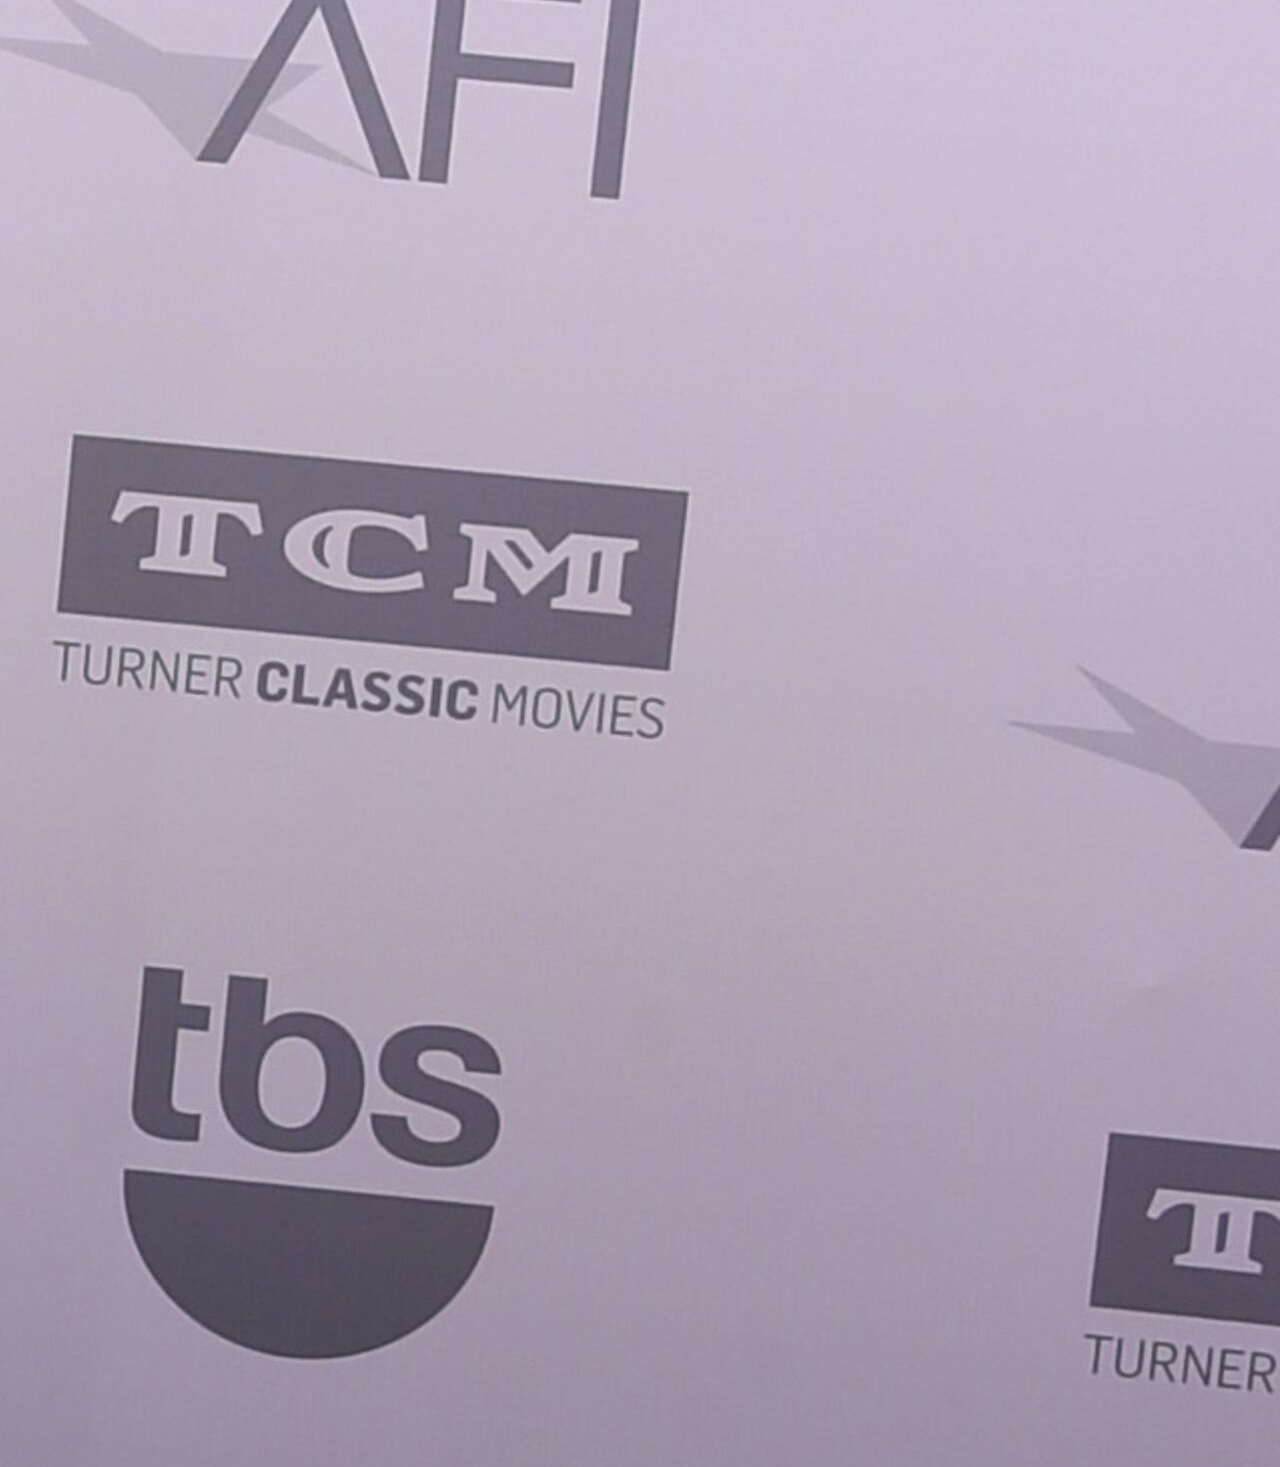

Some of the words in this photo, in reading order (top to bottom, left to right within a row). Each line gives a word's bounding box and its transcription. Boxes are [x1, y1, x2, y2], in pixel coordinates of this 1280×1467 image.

[110, 489, 640, 617] TCM
[52, 640, 243, 699] TURNER
[255, 660, 479, 721] CLASSIC
[491, 682, 666, 740] MOVIES
[131, 965, 502, 1168] tbs
[1083, 1332, 1278, 1394] TURNER
